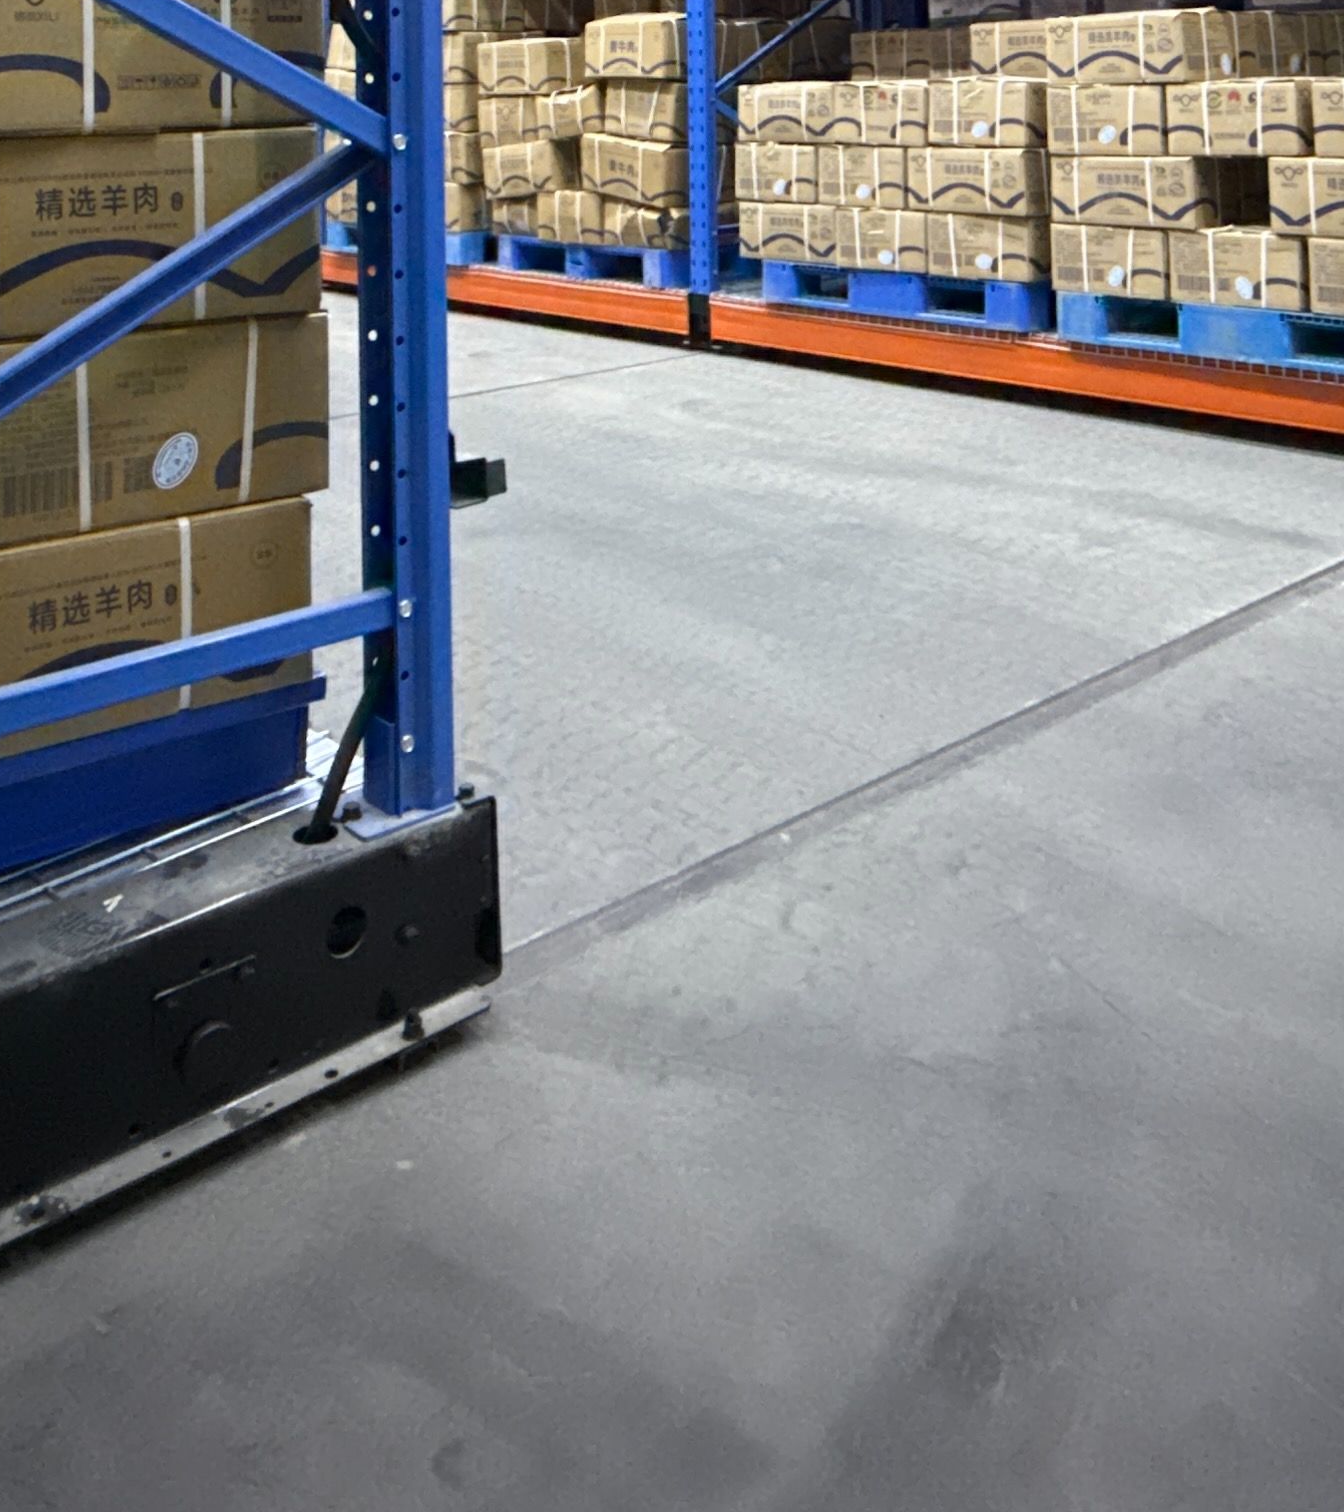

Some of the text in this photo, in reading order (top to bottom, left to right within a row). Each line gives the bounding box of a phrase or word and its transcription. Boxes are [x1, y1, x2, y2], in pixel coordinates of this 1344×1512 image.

[34, 180, 160, 222] 精选羊肉
[27, 580, 154, 635] 精选羊肉
